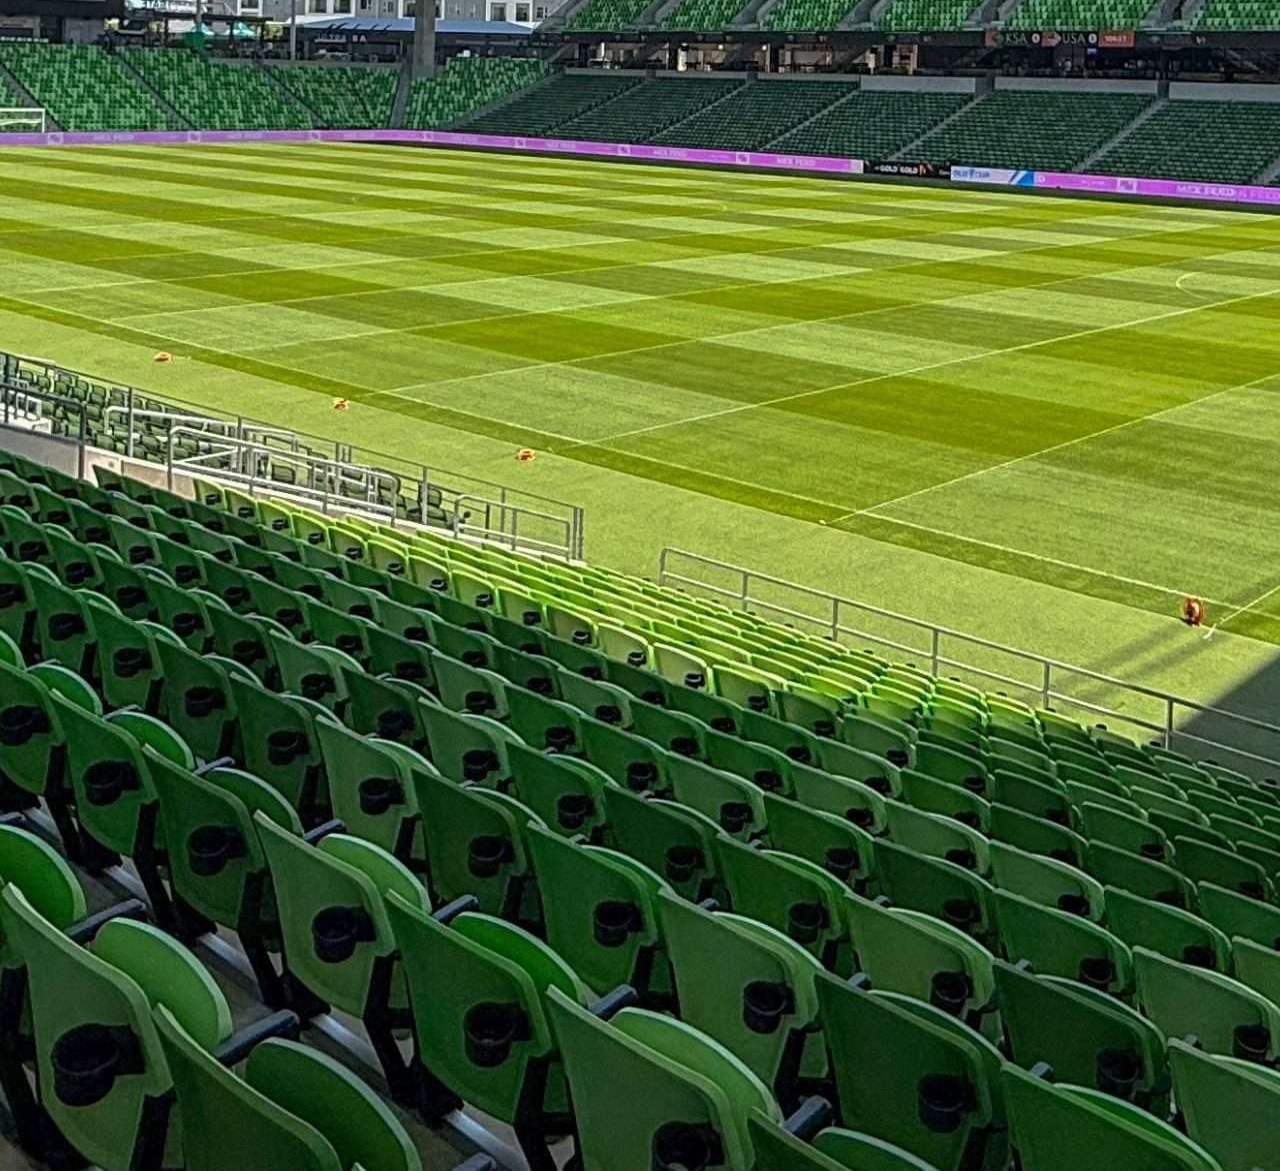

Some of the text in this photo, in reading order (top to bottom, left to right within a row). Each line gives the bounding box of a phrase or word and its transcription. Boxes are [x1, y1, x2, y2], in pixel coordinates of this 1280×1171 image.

[1006, 33, 1028, 45] KSA
[1031, 33, 1040, 44] 0
[1062, 33, 1086, 45] USA
[1088, 33, 1097, 44] 0
